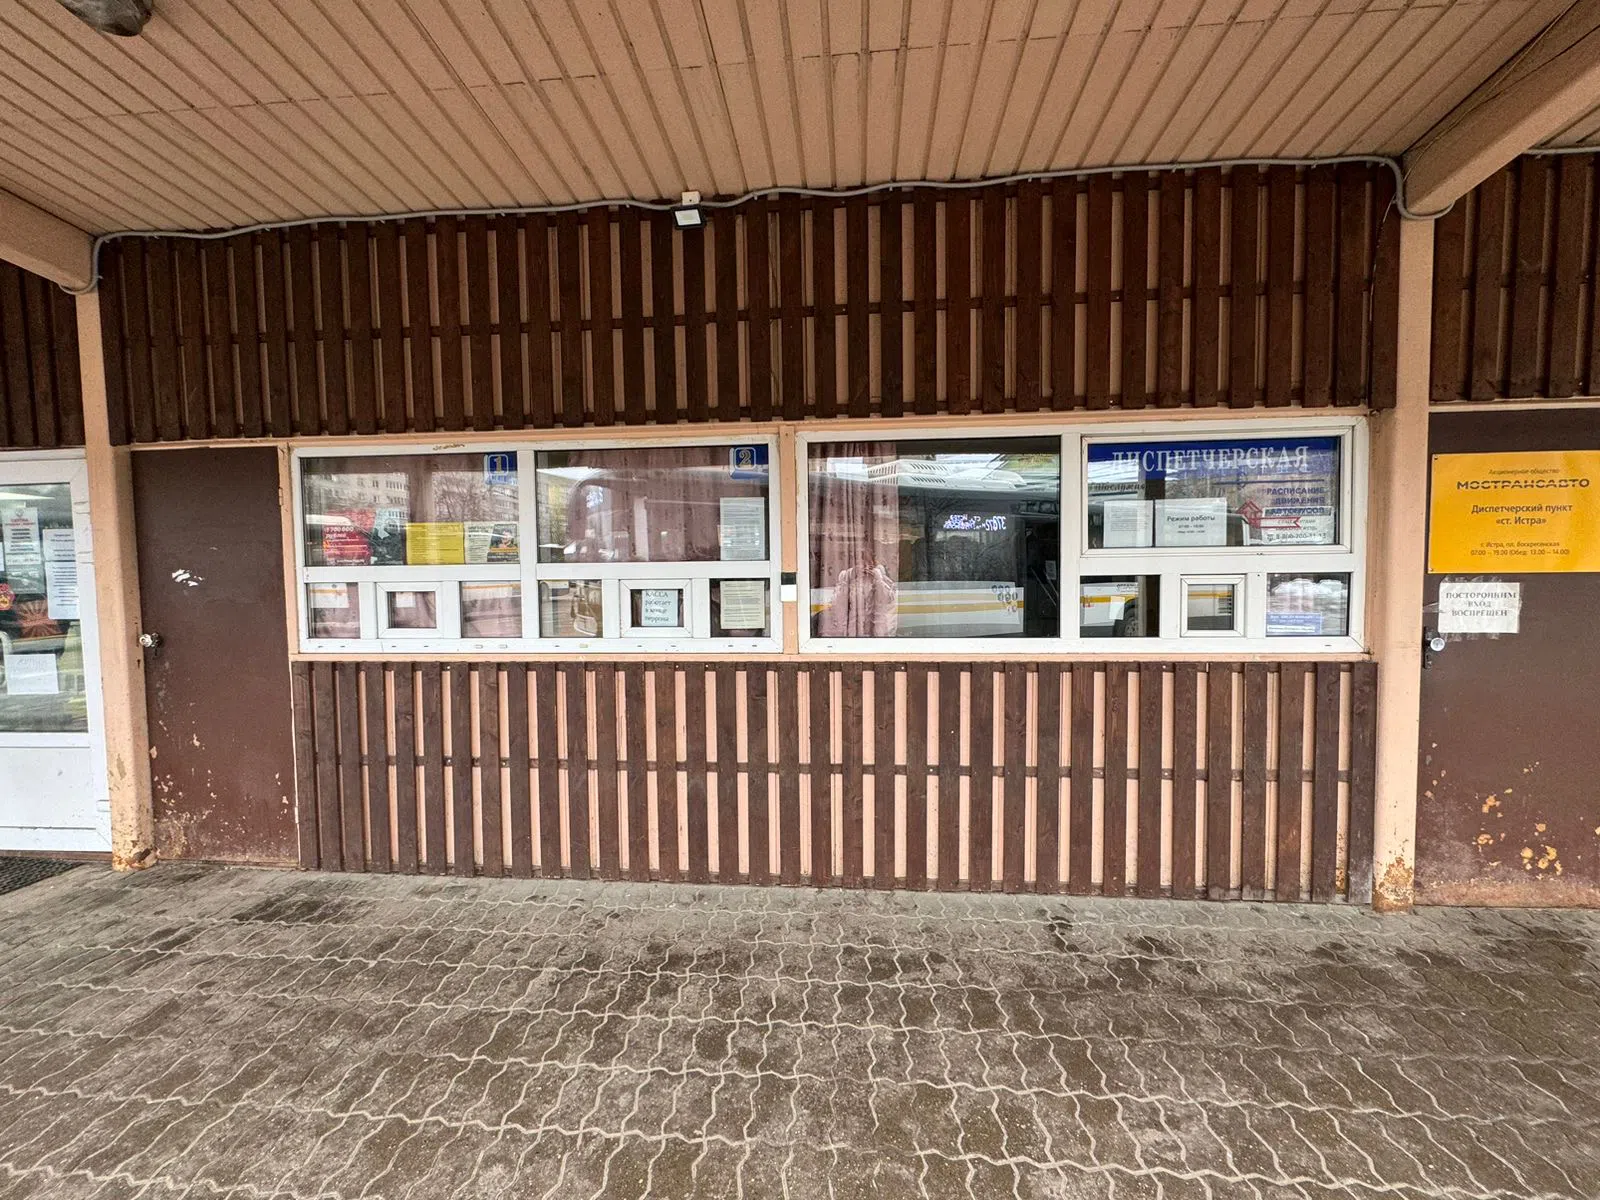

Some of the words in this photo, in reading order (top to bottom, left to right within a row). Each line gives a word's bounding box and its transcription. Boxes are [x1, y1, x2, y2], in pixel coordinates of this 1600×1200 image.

[738, 448, 752, 468] 2
[1111, 446, 1310, 473] ДИСПЕТЧЕРСКАЯ
[493, 455, 505, 474] 1
[1456, 478, 1590, 490] МОСТРАНСАВТО
[1266, 487, 1325, 495] РАСПИСАНИЕ
[1471, 504, 1543, 515] Диспетчерский
[1545, 504, 1573, 514] пункт
[1166, 515, 1190, 523] Режим
[1191, 514, 1216, 523] работы
[1495, 517, 1512, 525] «ст.
[1514, 516, 1547, 527] Истра»
[645, 590, 669, 598] КАССА
[1451, 609, 1508, 617] ВОСПРЕЩЕН
